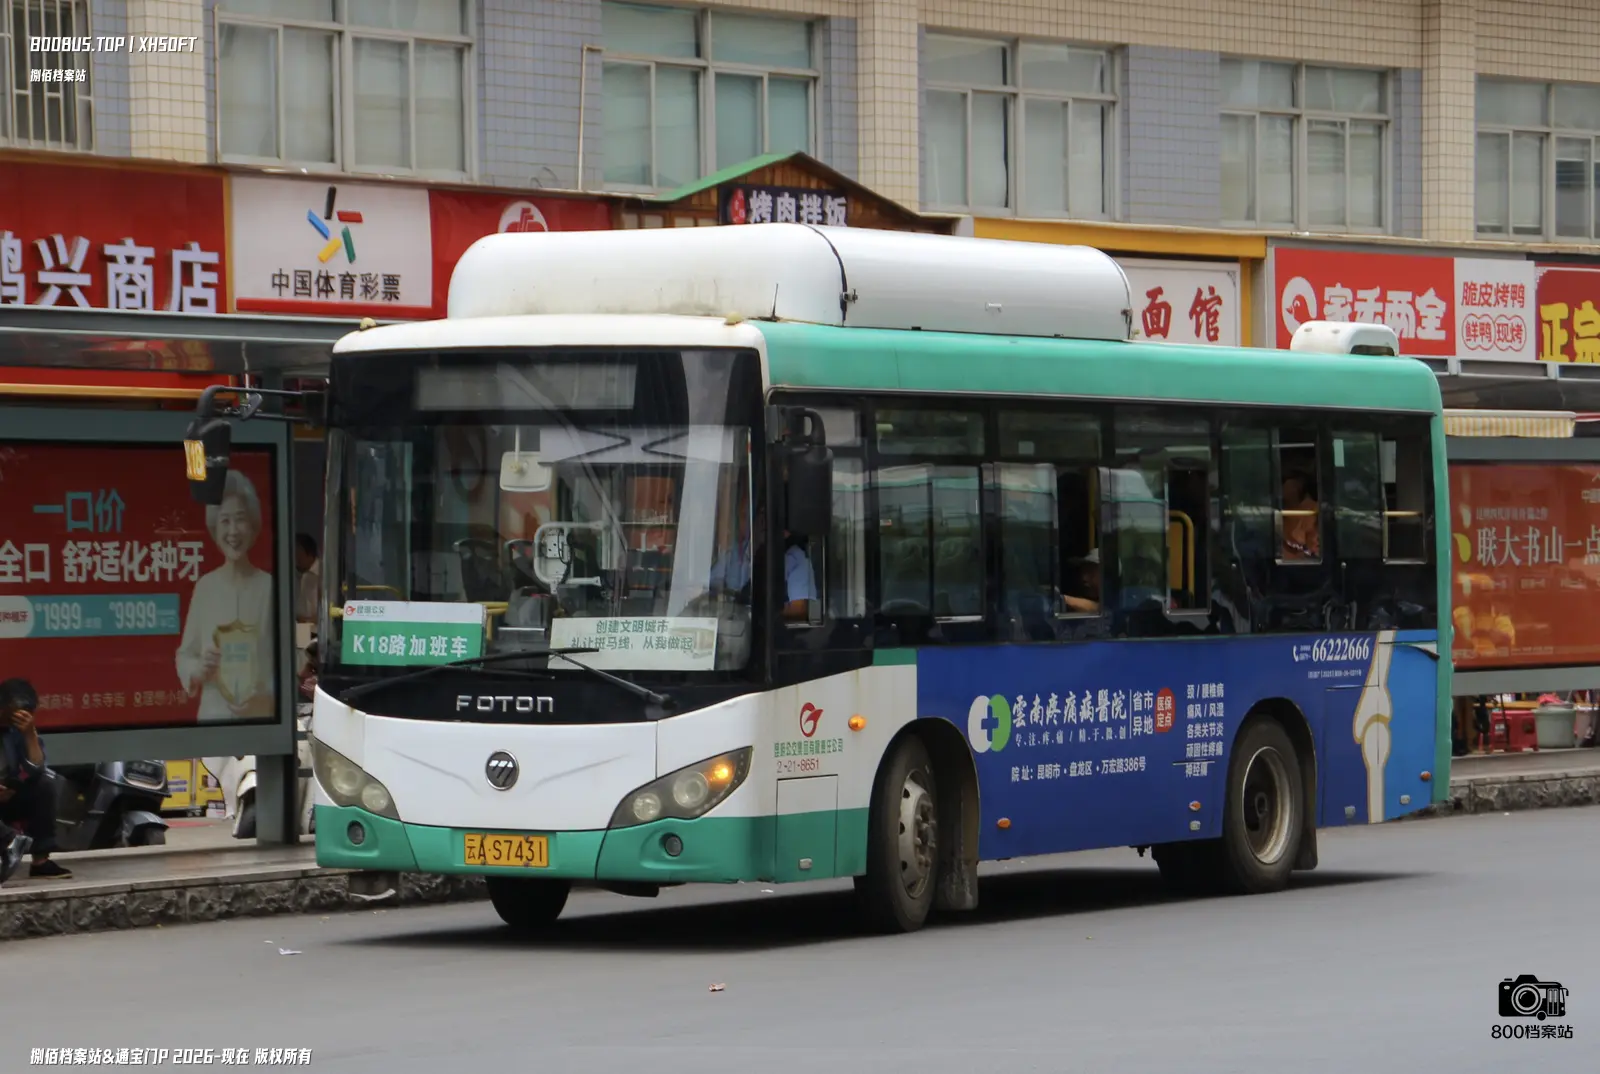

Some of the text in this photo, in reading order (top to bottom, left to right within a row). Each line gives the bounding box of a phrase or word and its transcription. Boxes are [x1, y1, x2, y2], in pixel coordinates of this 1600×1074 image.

[748, 189, 848, 227] 烤肉拌饭
[271, 268, 402, 301] 中国体育彩票
[1461, 280, 1526, 309] 脆皮烤鸭
[1141, 284, 1223, 343] 面馆
[1465, 321, 1525, 344] 鲜鸭 现烤
[33, 488, 126, 533] 一口价
[0, 540, 205, 583] 全口 舒适化种牙
[42, 601, 82, 630] 1999
[113, 600, 157, 630] 9999
[596, 619, 669, 634] 创建文明城市
[353, 634, 469, 659] K18路加班车
[1312, 637, 1371, 662] 66222666
[455, 694, 555, 714] FOTON
[1132, 690, 1154, 713] 省市
[1156, 695, 1173, 712] 医保
[1132, 714, 1154, 737] 异地
[1156, 712, 1173, 729] 定点
[1186, 721, 1225, 740] 各类关节炎
